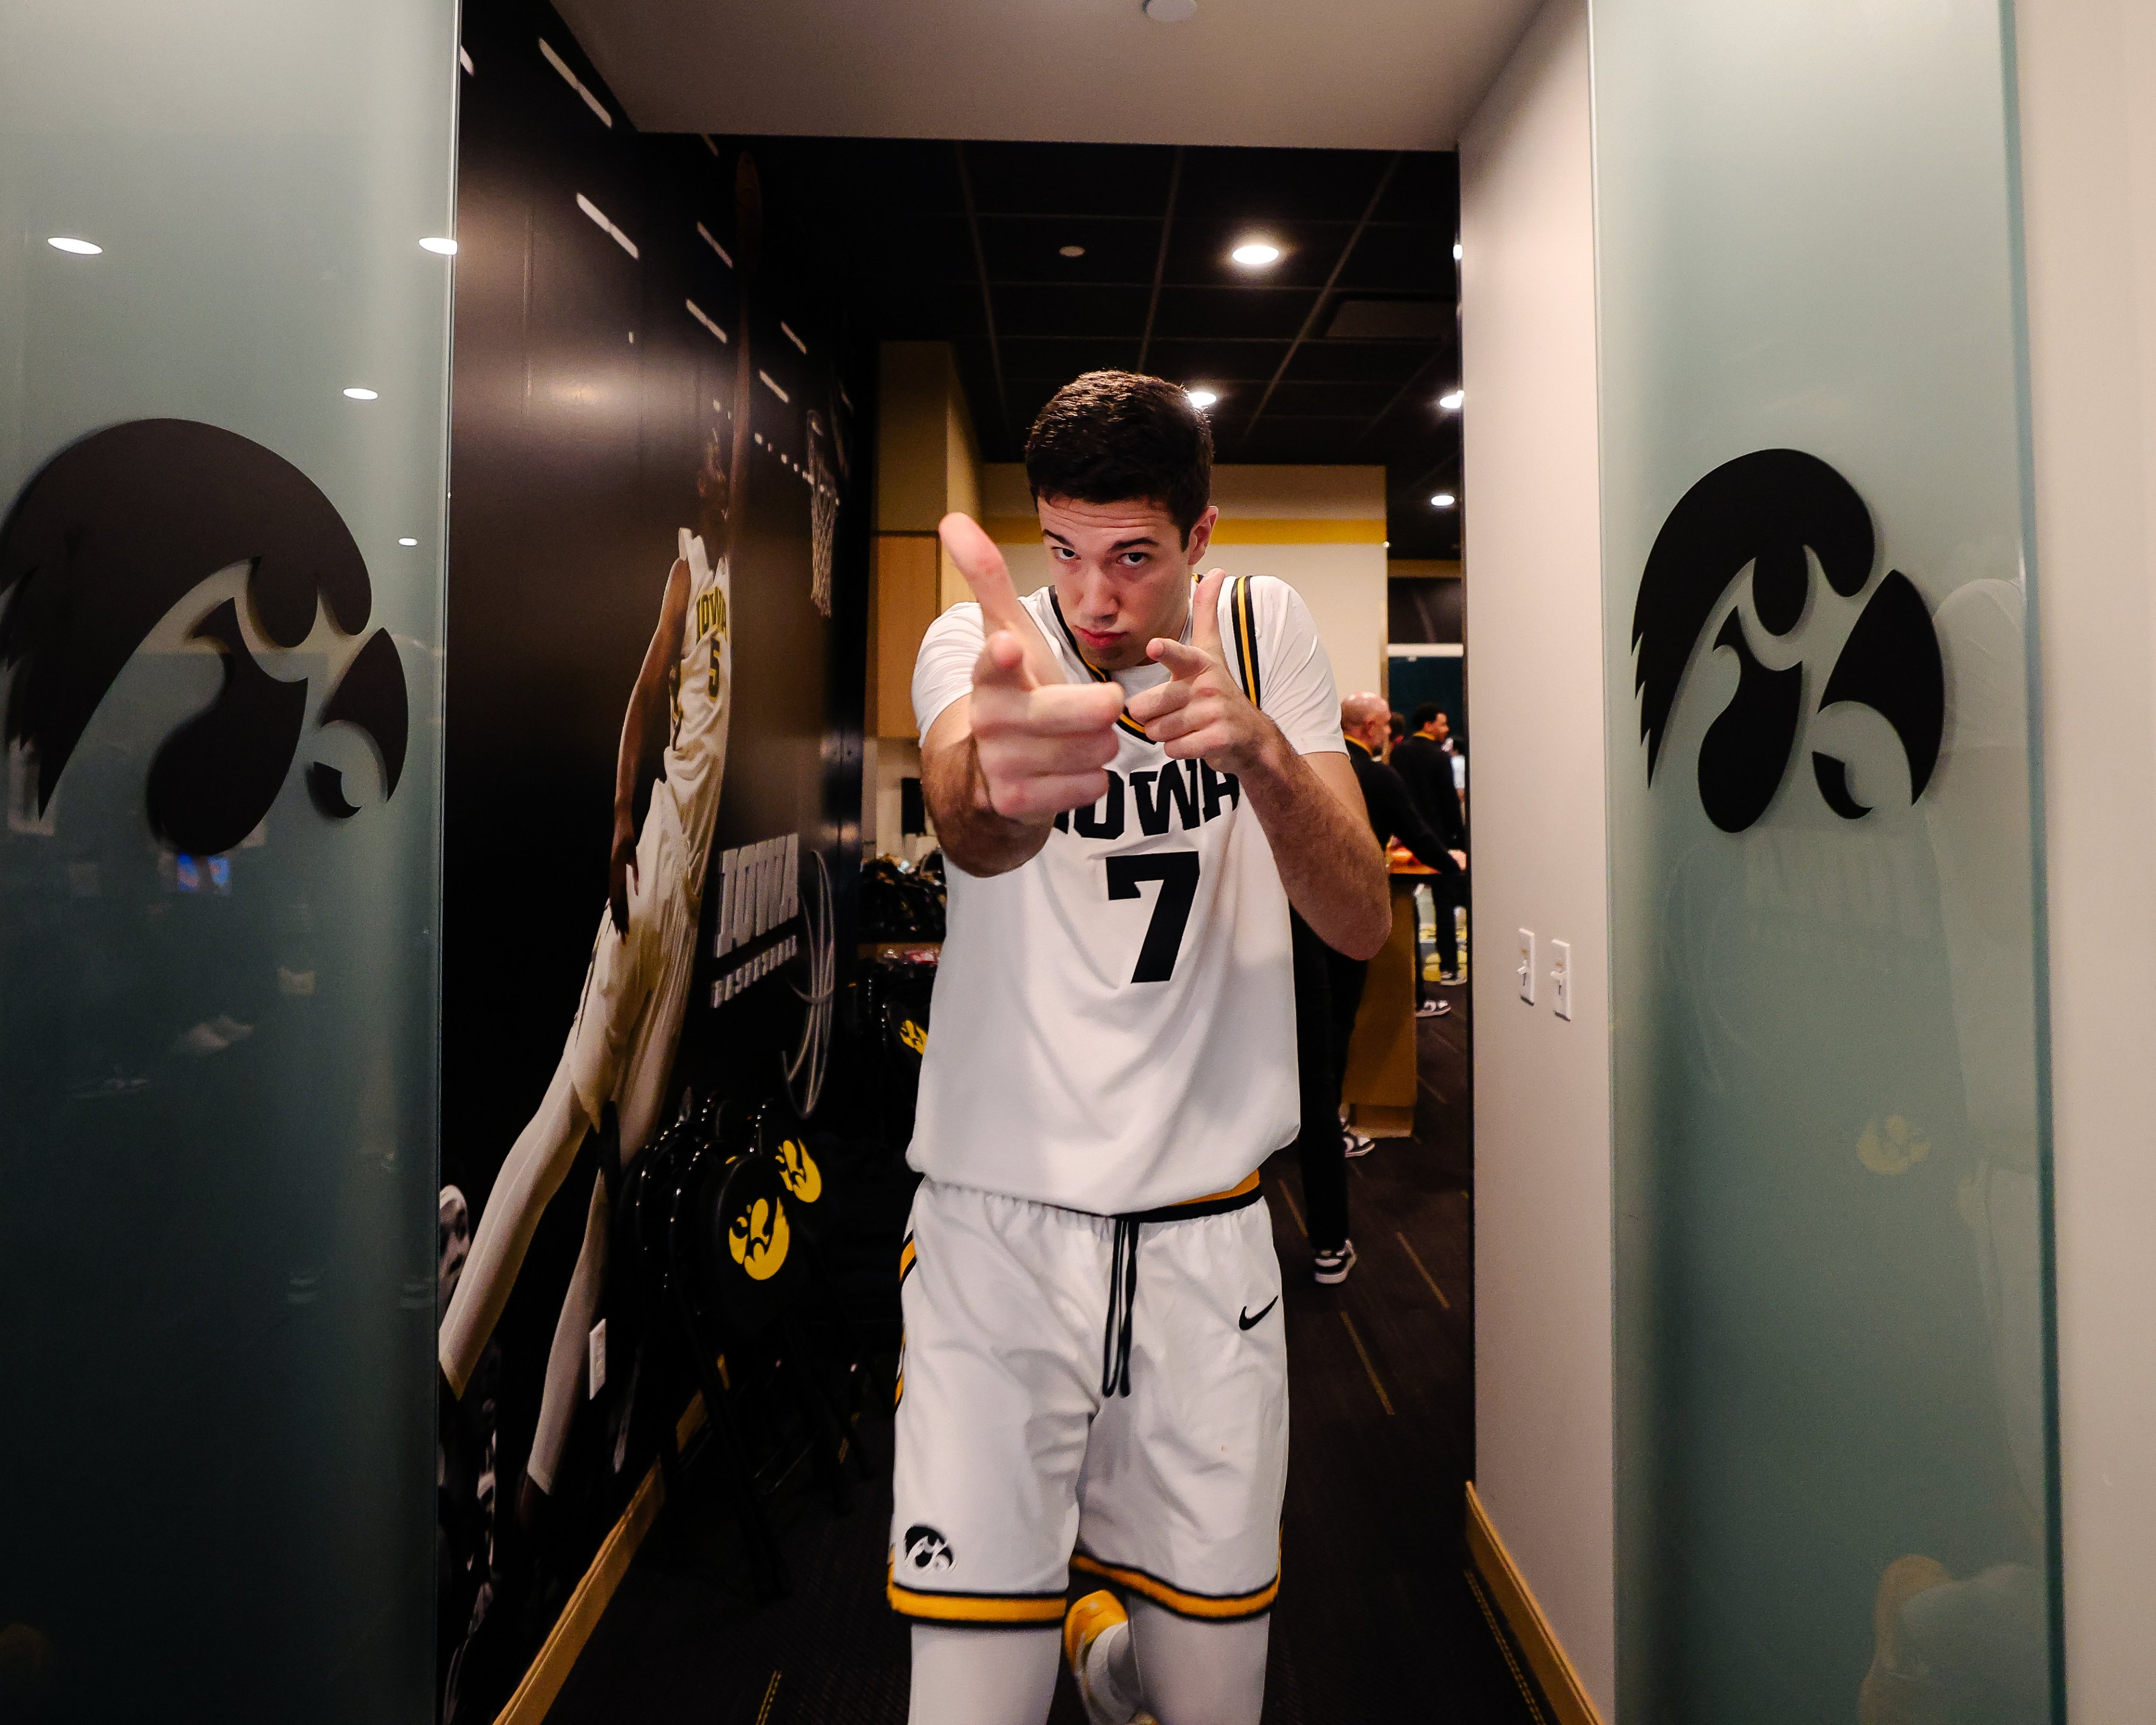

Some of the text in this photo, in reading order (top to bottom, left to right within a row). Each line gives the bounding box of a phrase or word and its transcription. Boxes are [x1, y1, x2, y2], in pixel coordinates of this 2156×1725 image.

[696, 586, 727, 645] IOWA
[708, 636, 721, 701] 5
[1054, 758, 1240, 840] OWA
[715, 832, 798, 958] IOWA
[1105, 851, 1200, 984] 7
